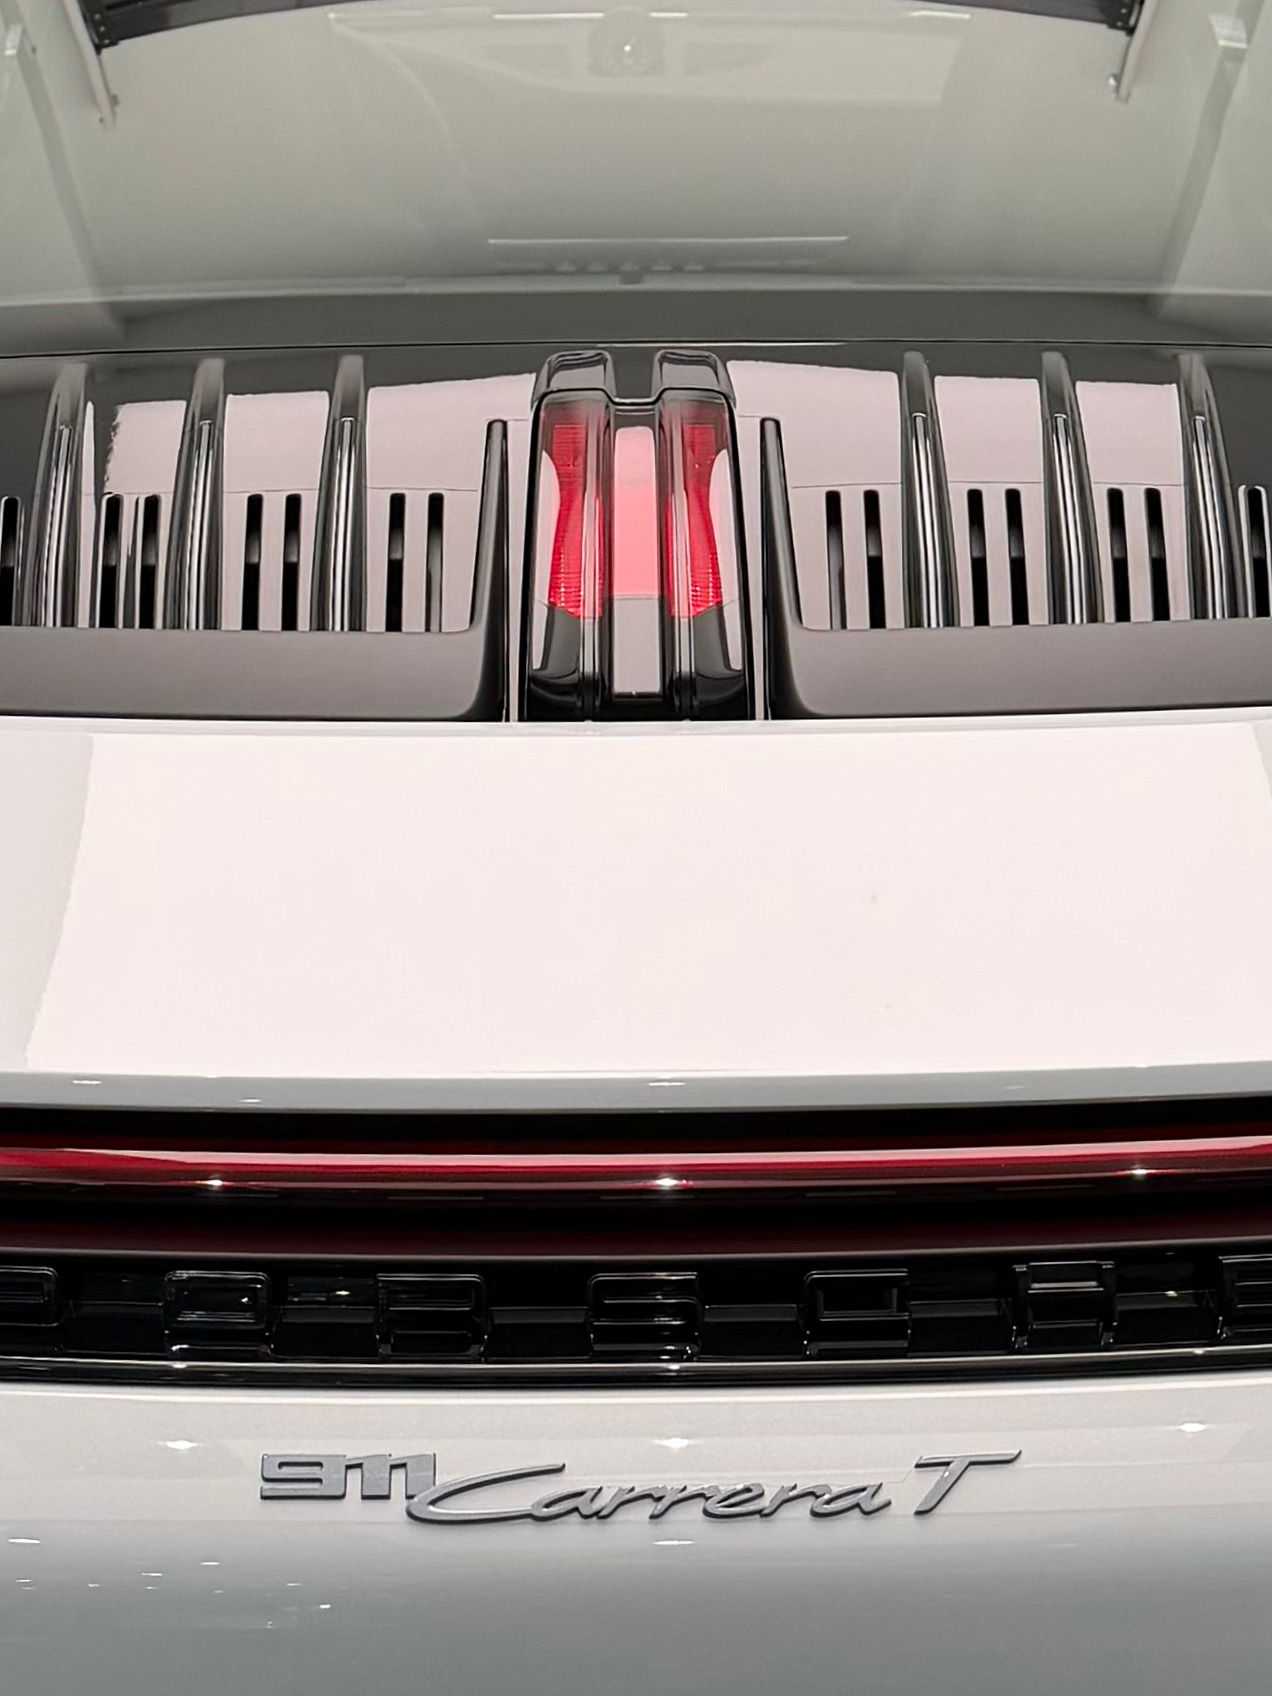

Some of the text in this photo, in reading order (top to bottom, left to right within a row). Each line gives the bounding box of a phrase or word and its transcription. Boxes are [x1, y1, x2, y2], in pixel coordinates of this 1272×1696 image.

[259, 1449, 1023, 1523] 911 Carrera T
